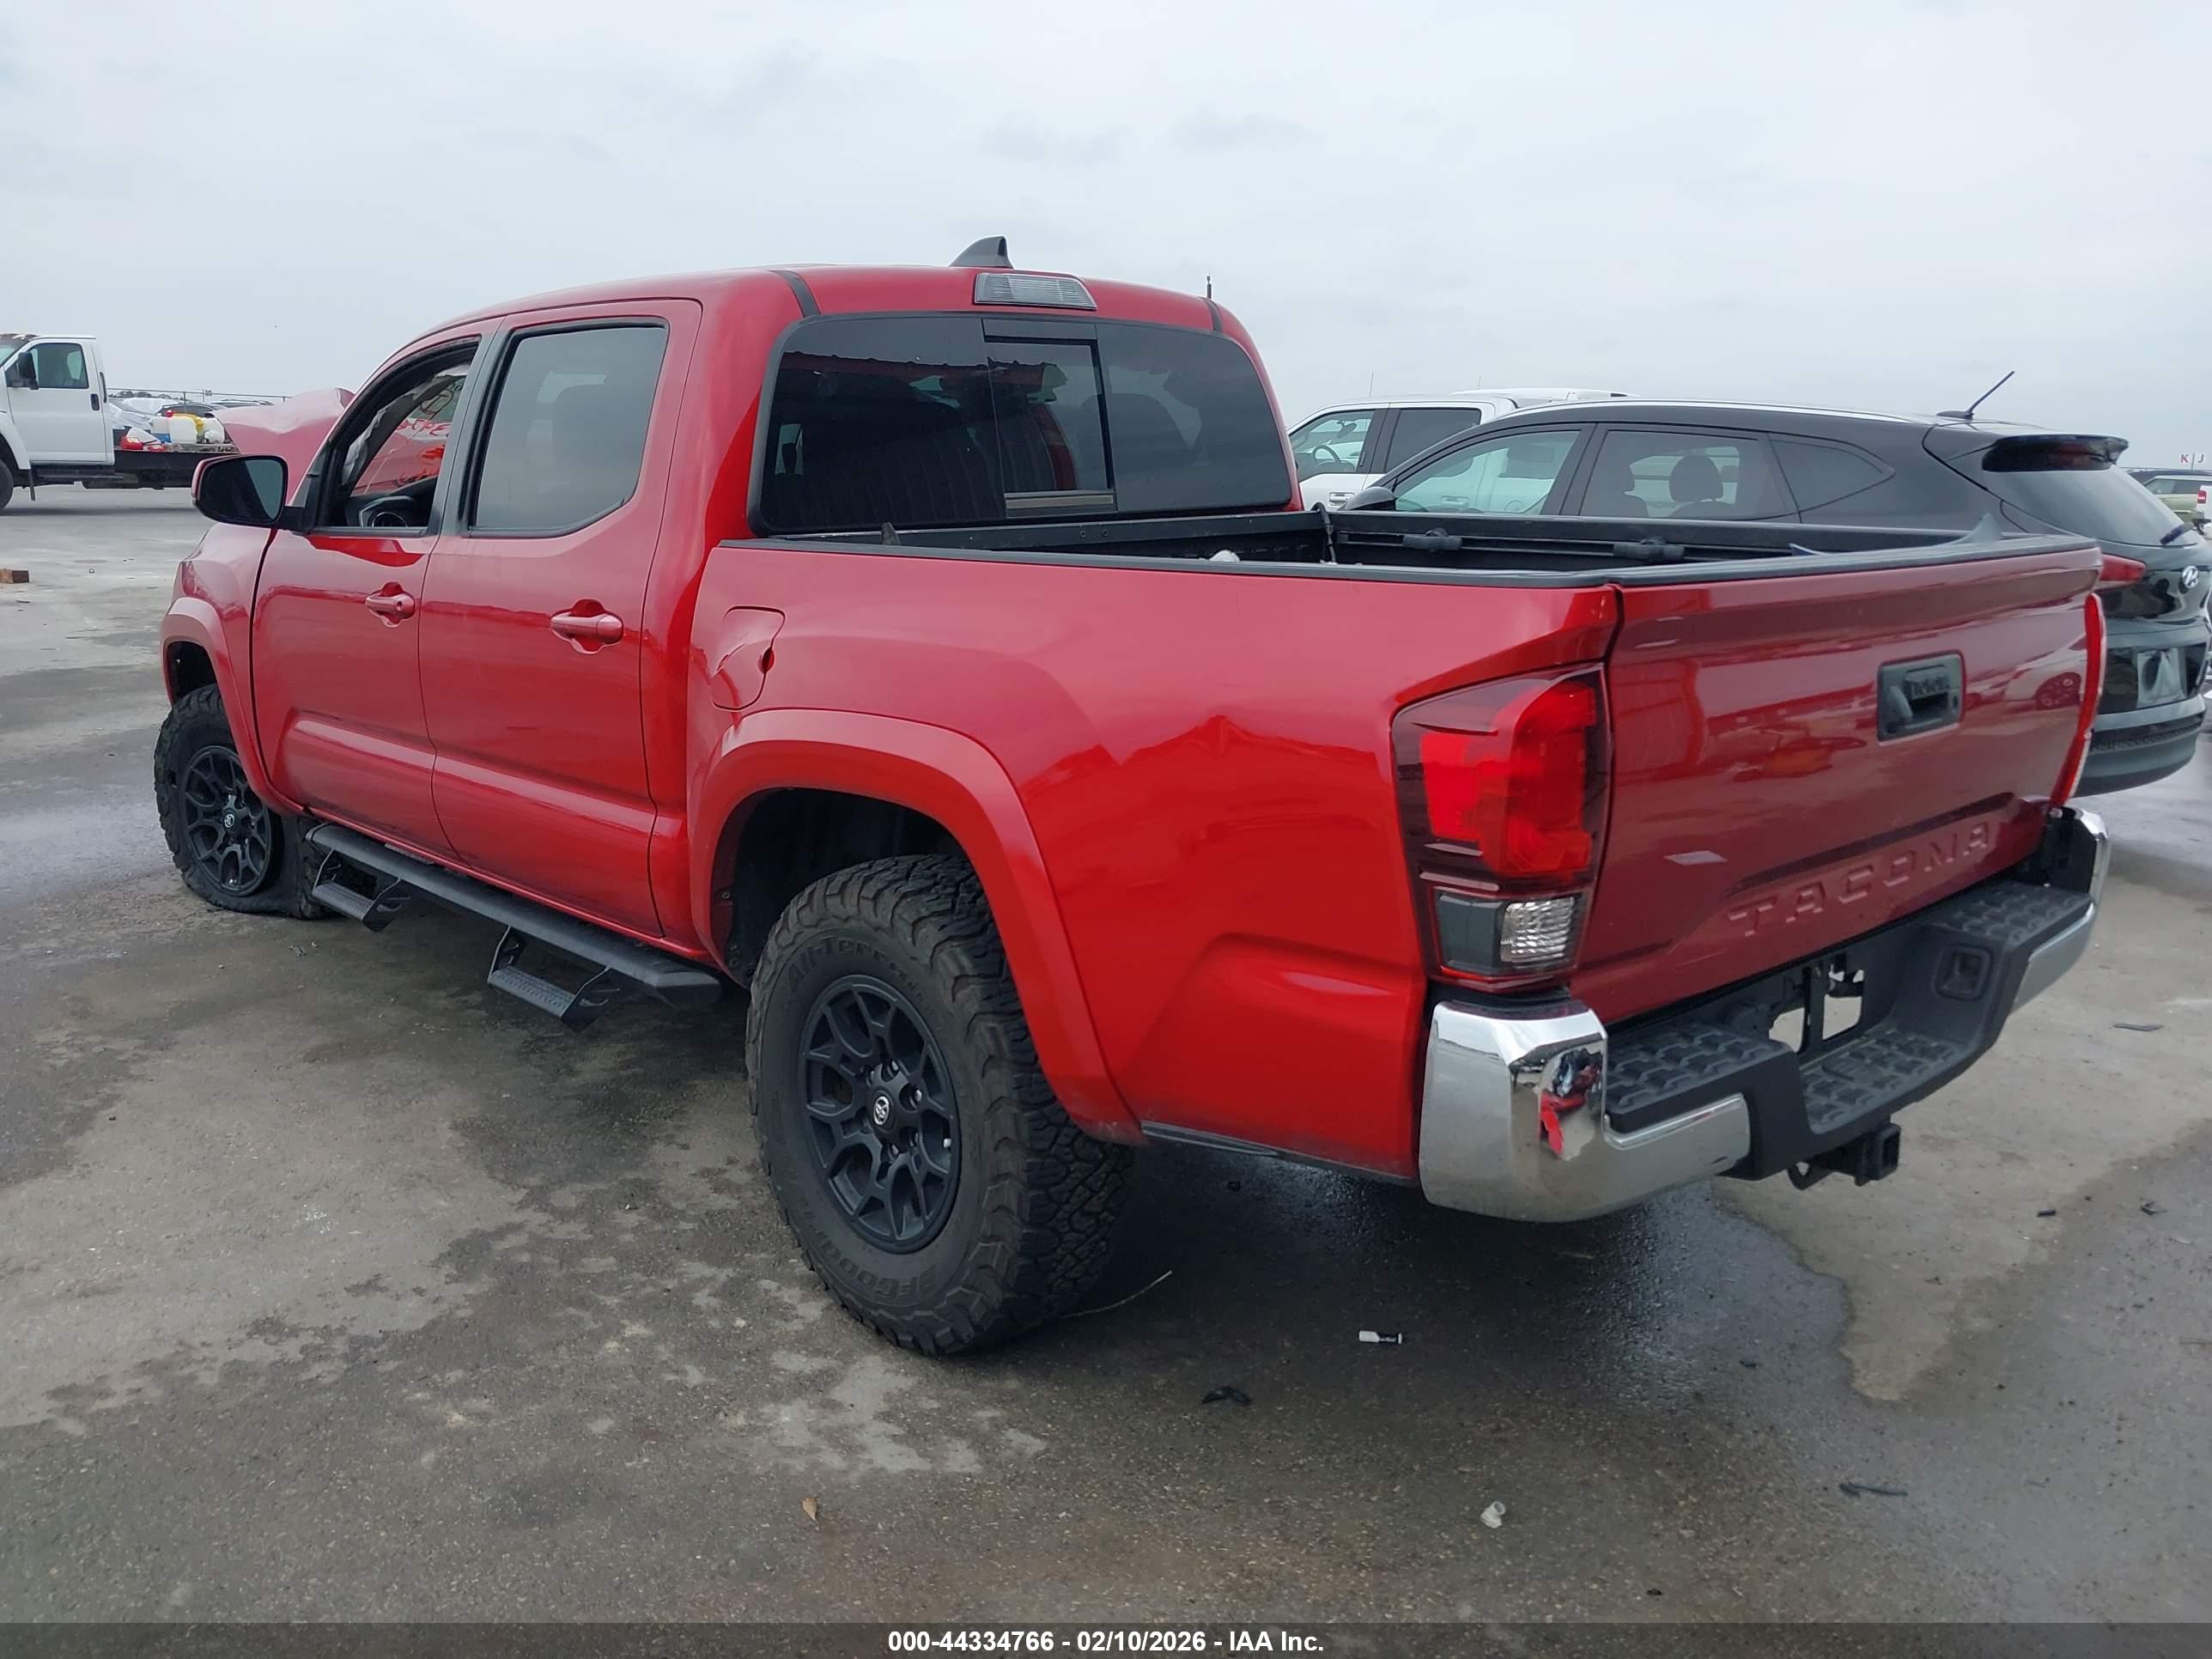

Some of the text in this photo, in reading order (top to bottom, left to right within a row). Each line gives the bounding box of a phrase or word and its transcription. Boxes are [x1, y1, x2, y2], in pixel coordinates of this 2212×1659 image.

[2180, 453, 2189, 463] K
[2197, 453, 2204, 463] J
[1728, 821, 1989, 935] TACOMA
